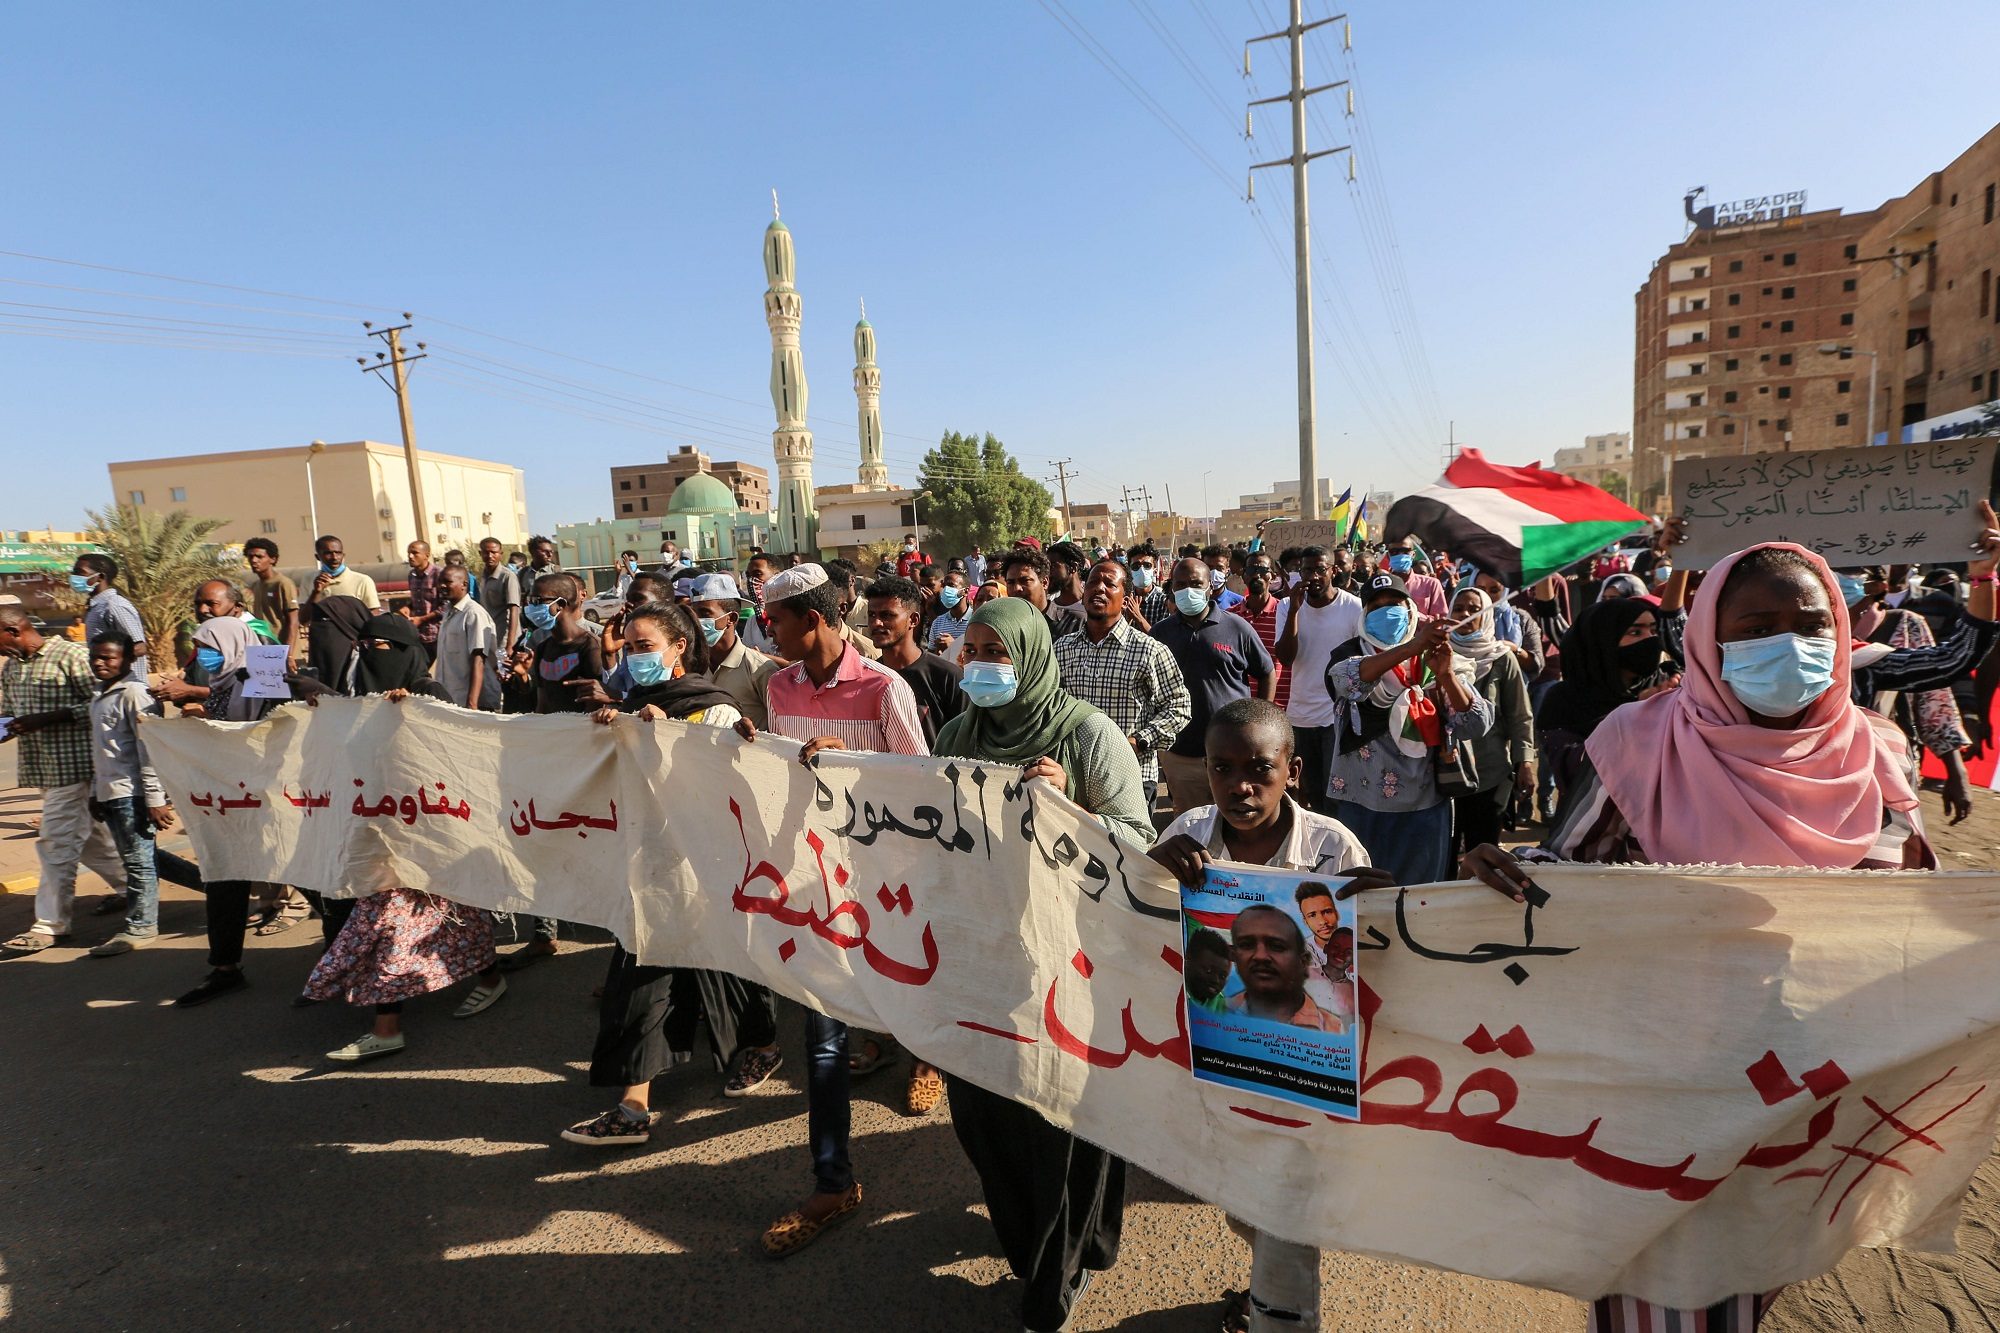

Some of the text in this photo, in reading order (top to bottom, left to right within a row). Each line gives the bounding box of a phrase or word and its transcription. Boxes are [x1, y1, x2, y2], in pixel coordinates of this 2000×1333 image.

[1718, 188, 1807, 214] ALBADRI
[1905, 449, 1925, 475] يا
[1824, 456, 1895, 485] صديقي
[1687, 467, 1747, 499] نستطيع
[190, 781, 262, 817] غرب
[351, 778, 471, 826] مقاومة
[510, 797, 618, 839] لجان
[1211, 877, 1240, 889] شهداء
[729, 796, 940, 986] تظبط
[1263, 1040, 1280, 1048] شارع
[1323, 1046, 1351, 1055] الشهيد
[1286, 1053, 1309, 1063] الجمعة
[1310, 1060, 1325, 1068] يوم
[1333, 1054, 1351, 1064] تاريخ
[1328, 1062, 1351, 1071] الوفاة
[1319, 1081, 1337, 1092] درقة
[1337, 1086, 1355, 1096] كانوا
